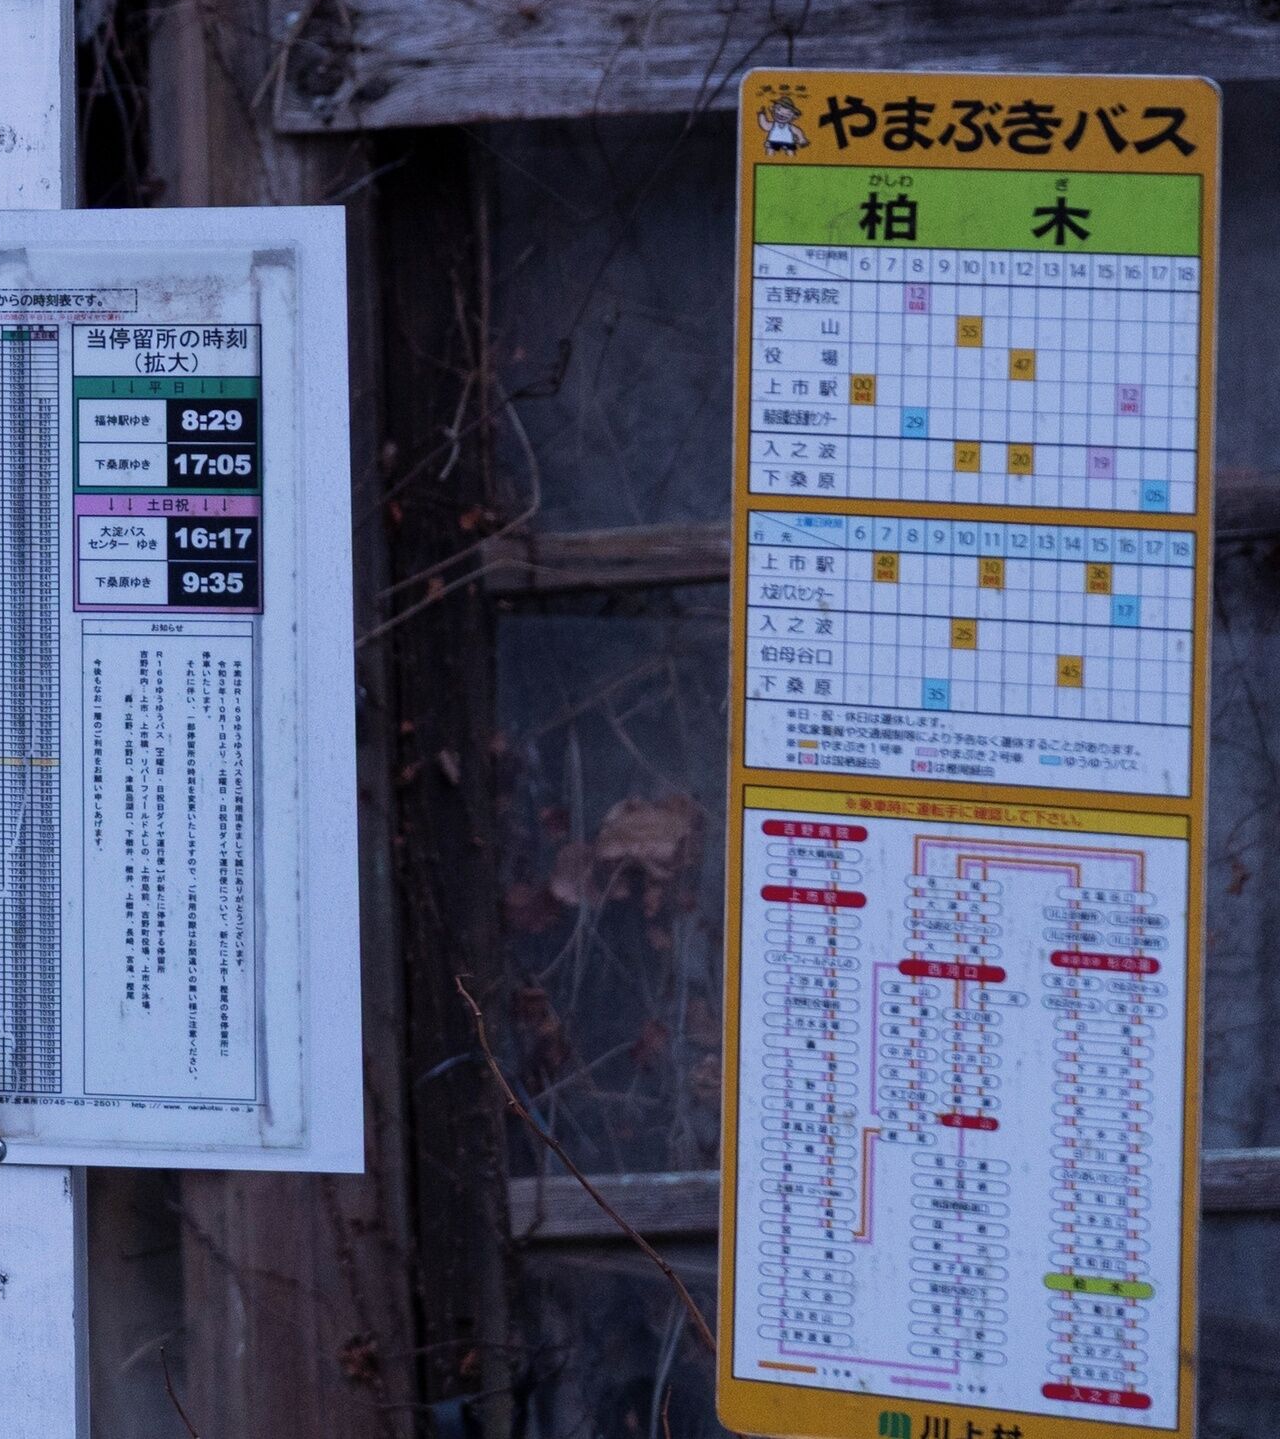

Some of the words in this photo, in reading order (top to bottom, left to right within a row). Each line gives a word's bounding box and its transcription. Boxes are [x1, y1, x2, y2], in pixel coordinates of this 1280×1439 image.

[818, 95, 1196, 157] やまぶきバス
[868, 174, 914, 188] かしわ
[1054, 178, 1069, 192] ぎ
[859, 256, 871, 272] 6
[886, 257, 897, 272] 7
[912, 258, 923, 273] 8
[939, 259, 950, 274] 9
[964, 260, 980, 274] 10
[990, 261, 1005, 275] 11
[1016, 262, 1033, 276] 12
[1044, 262, 1059, 277] 13
[1070, 263, 1086, 278] 14
[1098, 264, 1114, 279] 15
[1125, 265, 1141, 280] 16
[1152, 266, 1168, 280] 17
[1178, 266, 1194, 281] 18
[766, 287, 839, 304] 吉野病院
[87, 327, 248, 350] 当停留所の時刻
[134, 352, 199, 373] （拡大）
[149, 380, 185, 395] 平日
[764, 378, 838, 397] 上市駅
[94, 415, 151, 427] 福神駅ゆき
[181, 410, 243, 431] 8:29
[906, 416, 923, 429] 29
[763, 440, 836, 459] 入之波
[94, 459, 151, 471] 下桑原ゆき
[174, 453, 252, 475] 17:05
[763, 470, 835, 488] 下桑原
[147, 498, 190, 512] 土日祝
[88, 539, 129, 550] センター
[137, 539, 158, 550] ゆき
[100, 526, 146, 538] 大淀バス
[174, 527, 253, 549] 16:17
[855, 525, 866, 540] 6
[881, 526, 892, 541] 7
[907, 528, 918, 542] 8
[933, 529, 945, 544] 9
[957, 530, 976, 546] 10
[984, 532, 1000, 547] 11
[1011, 533, 1028, 548] 12
[1038, 534, 1055, 549] 13
[1064, 536, 1081, 551] 14
[1091, 537, 1108, 552] 15
[1118, 538, 1136, 554] 16
[1145, 540, 1163, 555] 17
[1172, 541, 1189, 557] 18
[762, 554, 834, 573] 上市駅
[95, 577, 152, 589] 下桑原ゆき
[182, 571, 245, 594] 9:35
[151, 623, 184, 632] お知らせ
[759, 615, 833, 635] 入之波
[760, 646, 833, 665] 伯母谷口
[202, 651, 211, 719] 停車いたします。
[760, 675, 832, 696] 下桑原
[927, 688, 945, 701] 35
